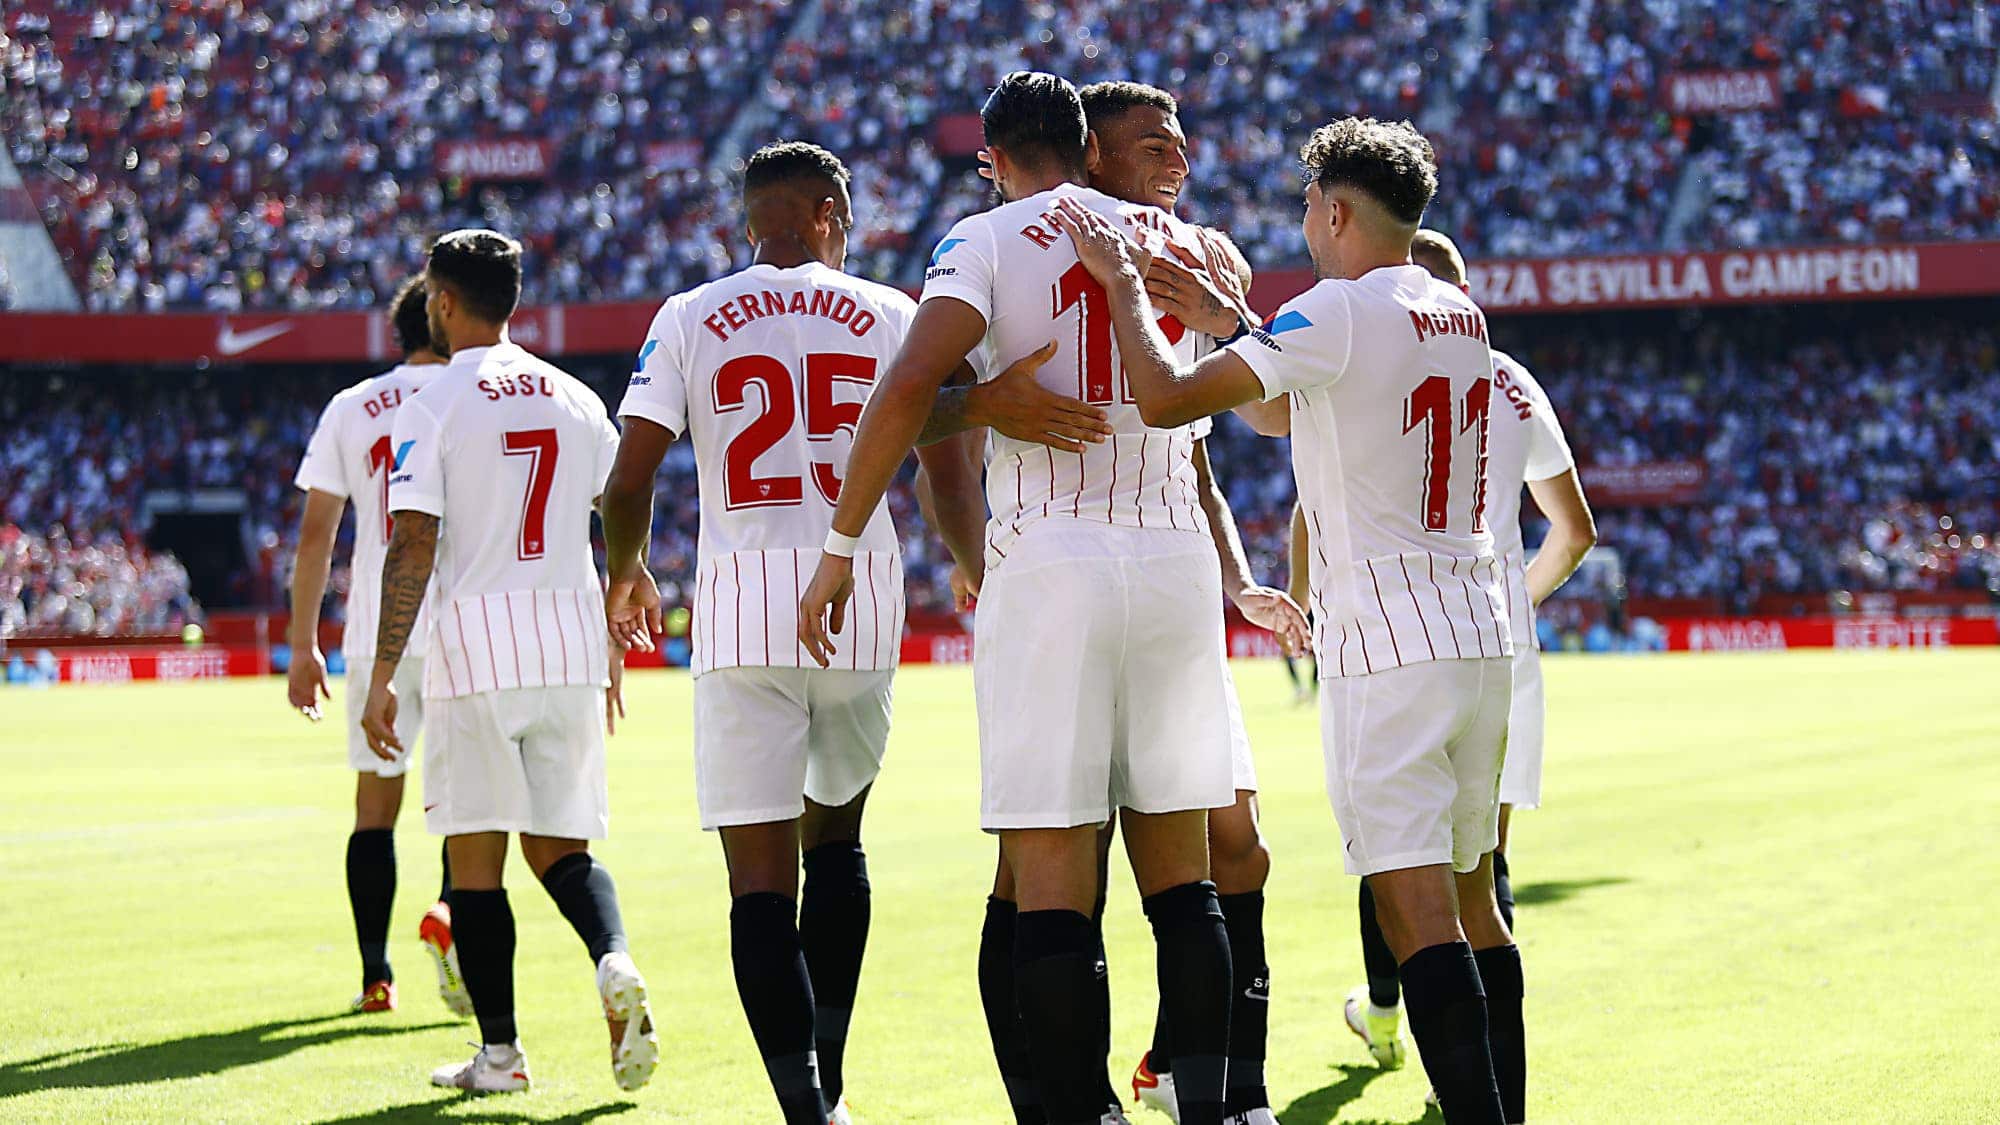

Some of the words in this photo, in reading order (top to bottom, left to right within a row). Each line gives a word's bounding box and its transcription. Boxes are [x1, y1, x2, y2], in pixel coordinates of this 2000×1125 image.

[703, 289, 876, 343] FERNANDO
[1547, 257, 1708, 304] SEVILLA
[1721, 250, 1920, 294] CAMPEON
[502, 428, 560, 562] 7
[711, 352, 878, 512] 25
[1402, 375, 1491, 534] 11
